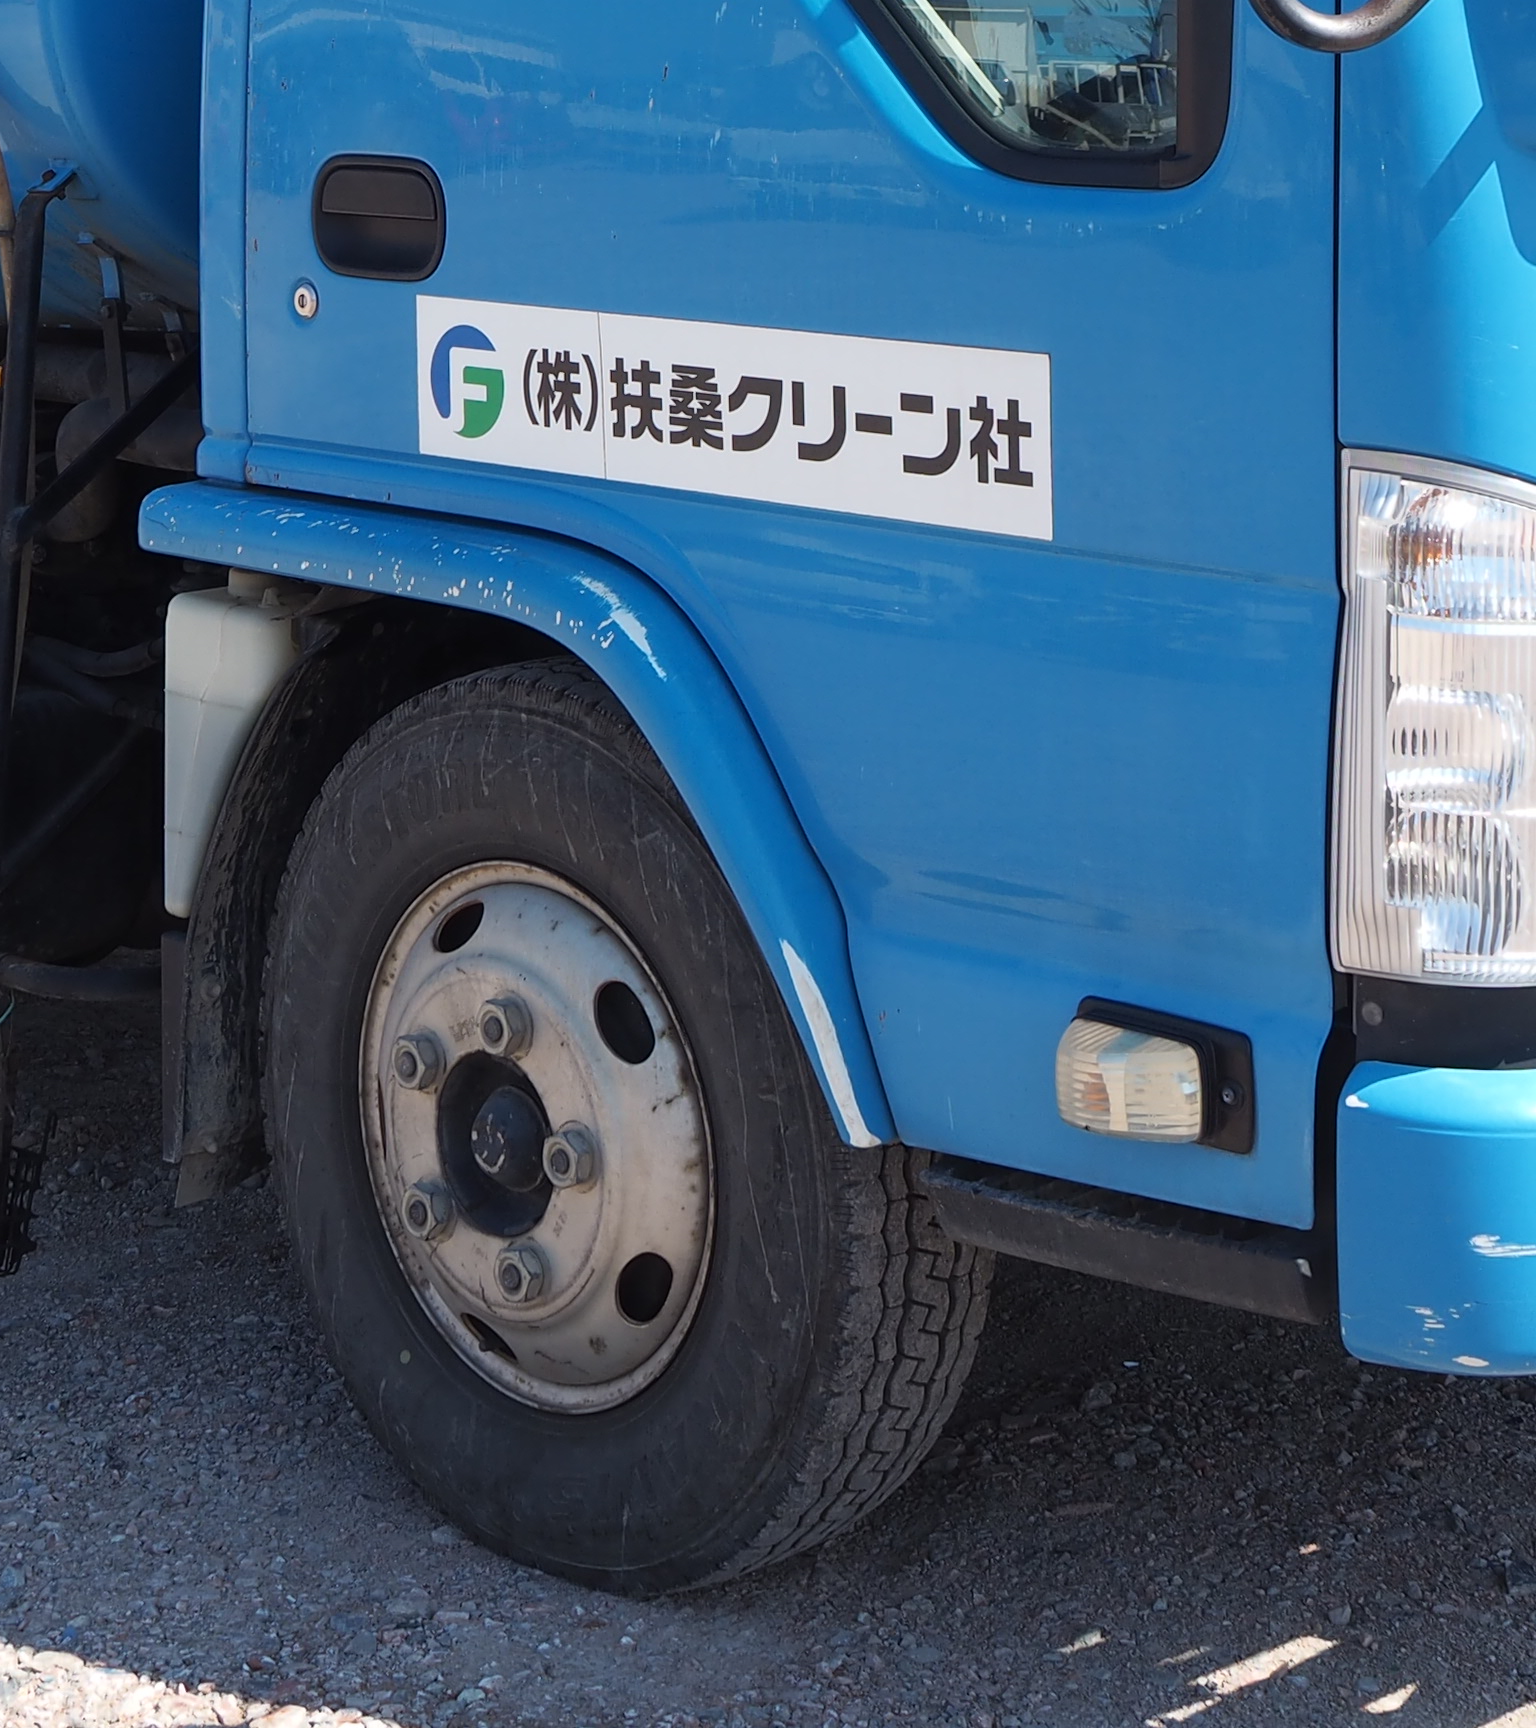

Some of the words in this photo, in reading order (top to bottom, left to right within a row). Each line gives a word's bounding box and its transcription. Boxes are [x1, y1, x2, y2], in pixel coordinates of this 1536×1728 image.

[523, 346, 1034, 488] (株)扶桑クリーン社
